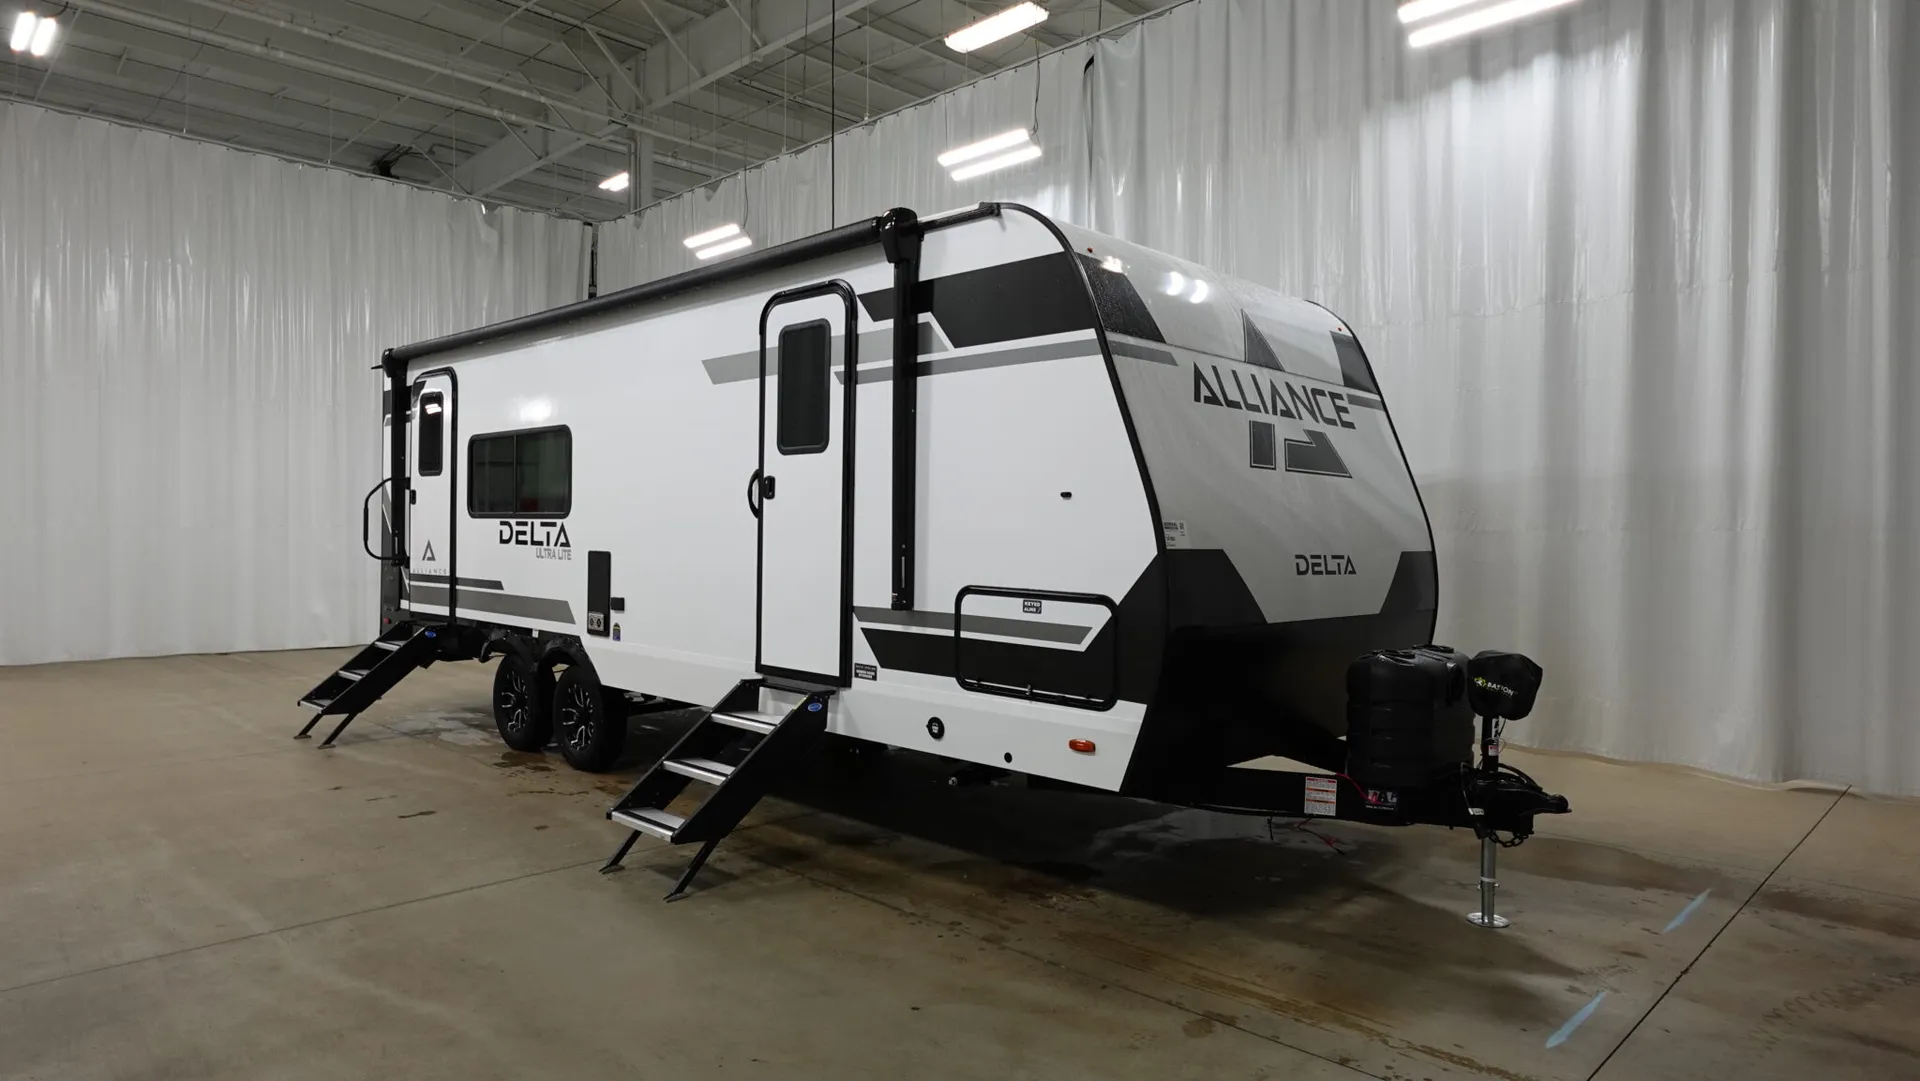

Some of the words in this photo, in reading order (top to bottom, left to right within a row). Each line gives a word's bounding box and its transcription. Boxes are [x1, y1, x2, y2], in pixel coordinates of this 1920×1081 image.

[1193, 361, 1357, 430] ALLIANCE
[499, 520, 571, 548] DELTA
[535, 547, 557, 559] ULTRA
[558, 548, 572, 561] LITE
[1294, 554, 1357, 576] DELTA
